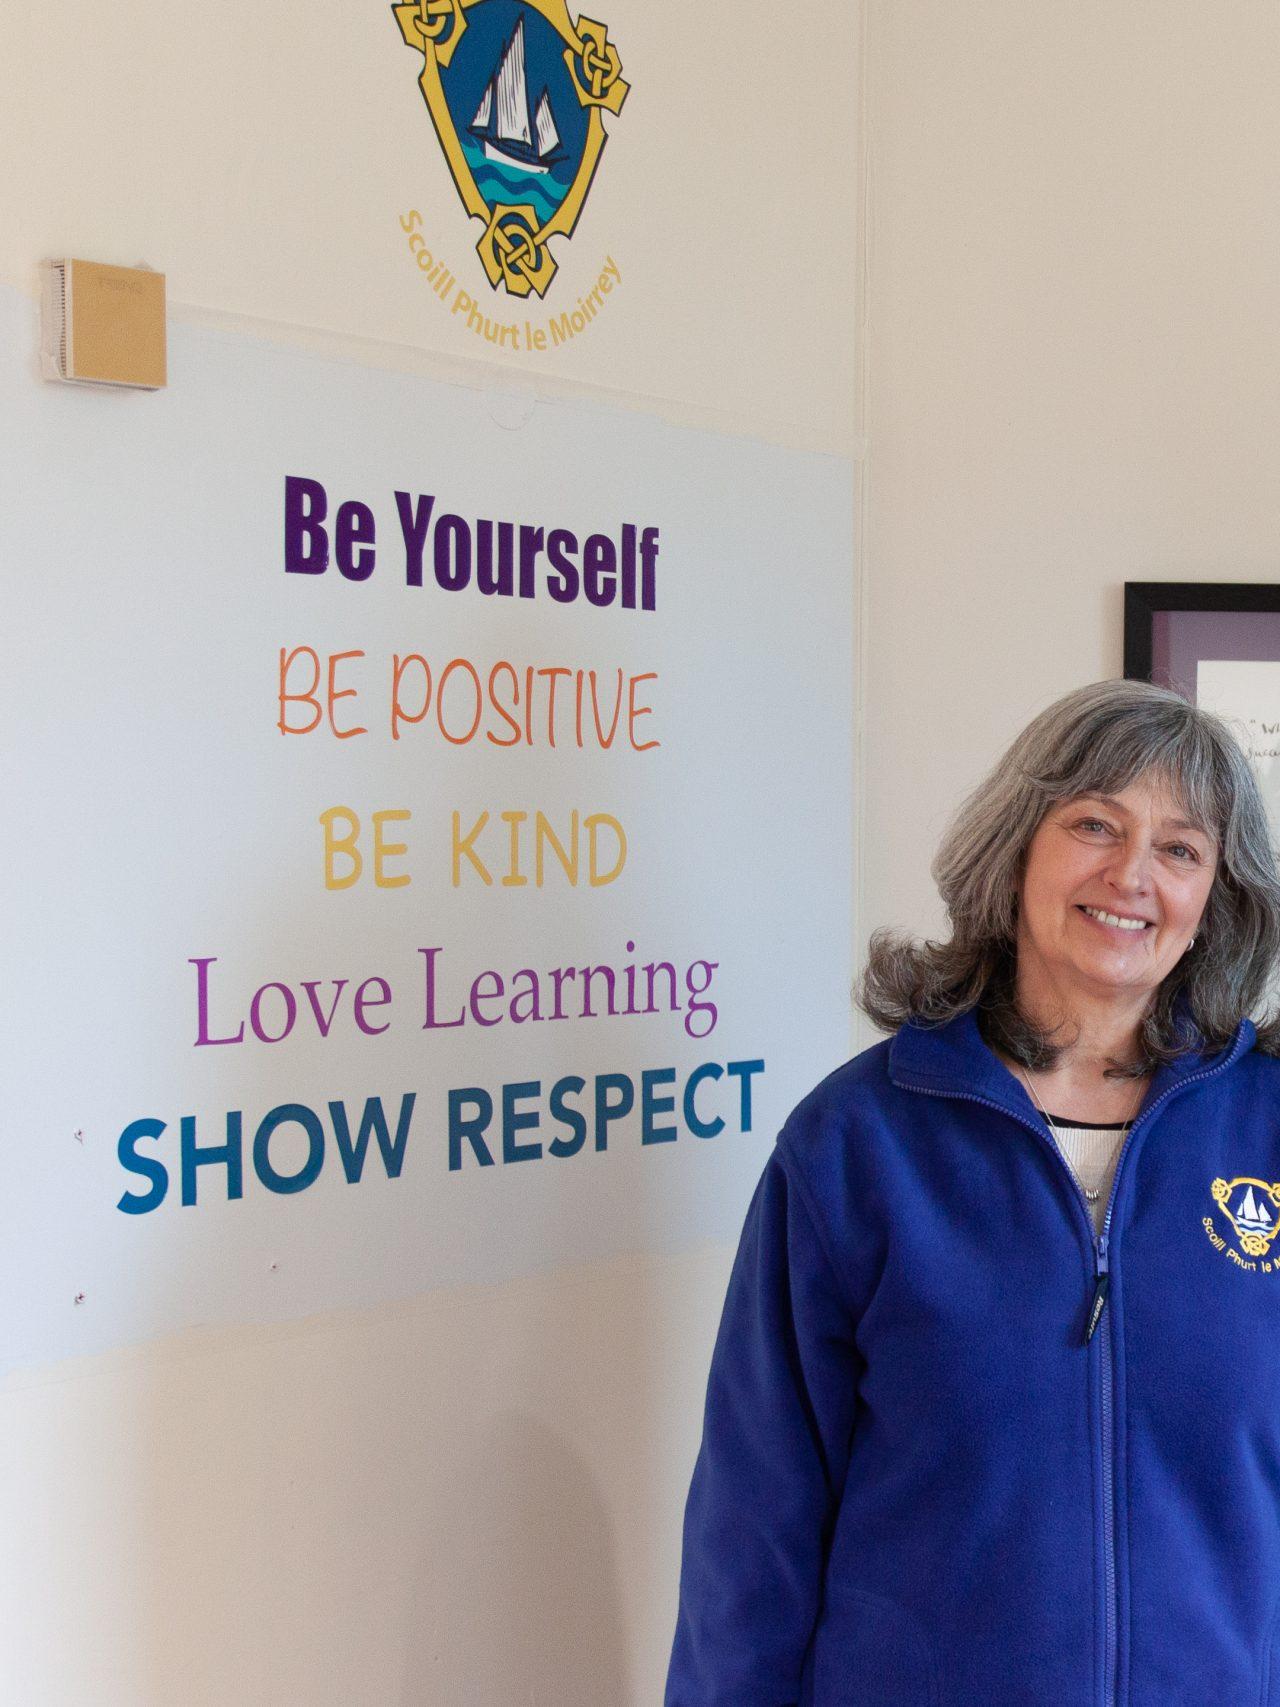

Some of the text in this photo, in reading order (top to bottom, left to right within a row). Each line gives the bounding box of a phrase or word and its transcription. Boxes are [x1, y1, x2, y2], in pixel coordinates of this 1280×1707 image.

[399, 209, 623, 351] Scoill Phurt le Moirrey
[284, 475, 660, 611] Be Yourself
[276, 646, 662, 752] BE POSITIVE
[319, 805, 628, 891] BE KIND
[188, 940, 720, 1048] Love Learning
[116, 1058, 766, 1216] SHOW RESPECT
[1202, 1217, 1227, 1252] Scoill
[1226, 1248, 1257, 1272] Phurt
[1261, 1261, 1272, 1274] le
